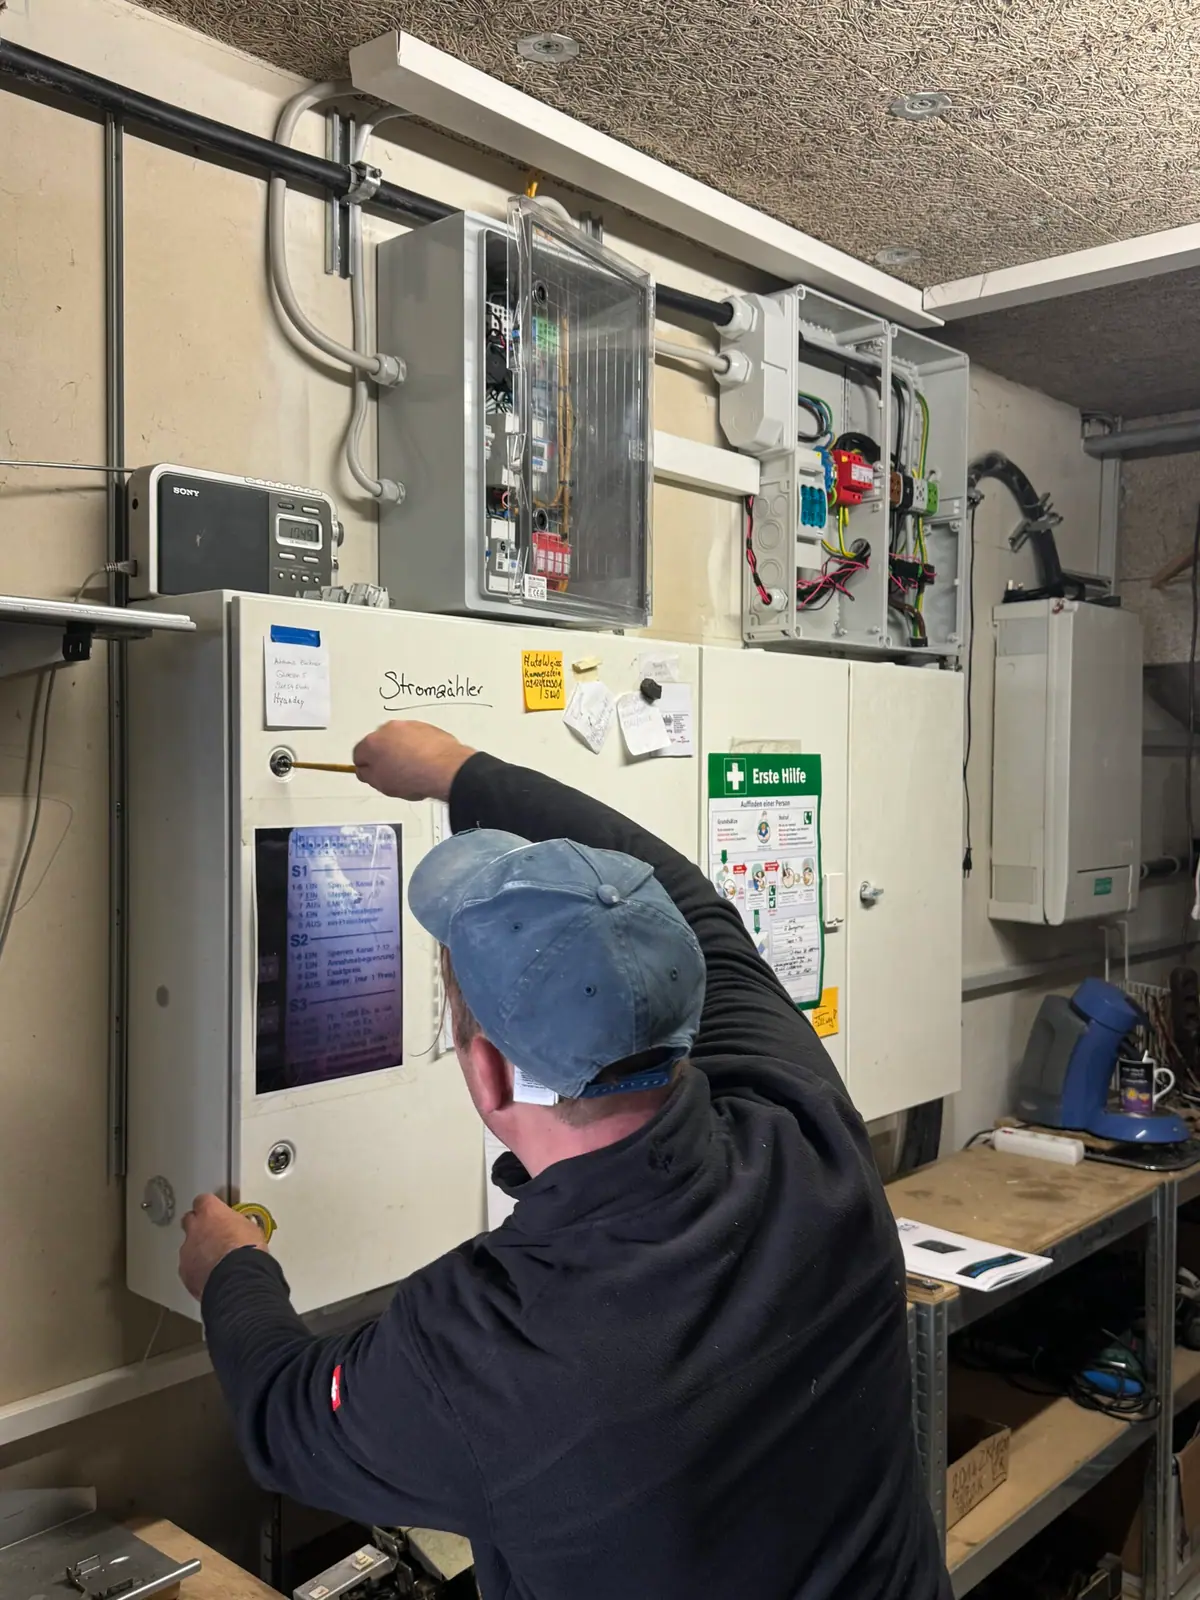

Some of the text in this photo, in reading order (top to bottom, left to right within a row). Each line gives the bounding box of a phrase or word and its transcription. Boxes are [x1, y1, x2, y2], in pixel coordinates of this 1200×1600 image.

[173, 486, 200, 497] SONY
[379, 671, 483, 699] Stromzähler
[752, 767, 806, 784] Erste Hilfe
[740, 800, 762, 808] Auffinden
[776, 799, 790, 807] Person
[291, 865, 308, 877] S1
[290, 933, 309, 947] S2
[305, 962, 318, 970] EIN
[305, 980, 321, 989] AUS
[290, 997, 307, 1013] S3
